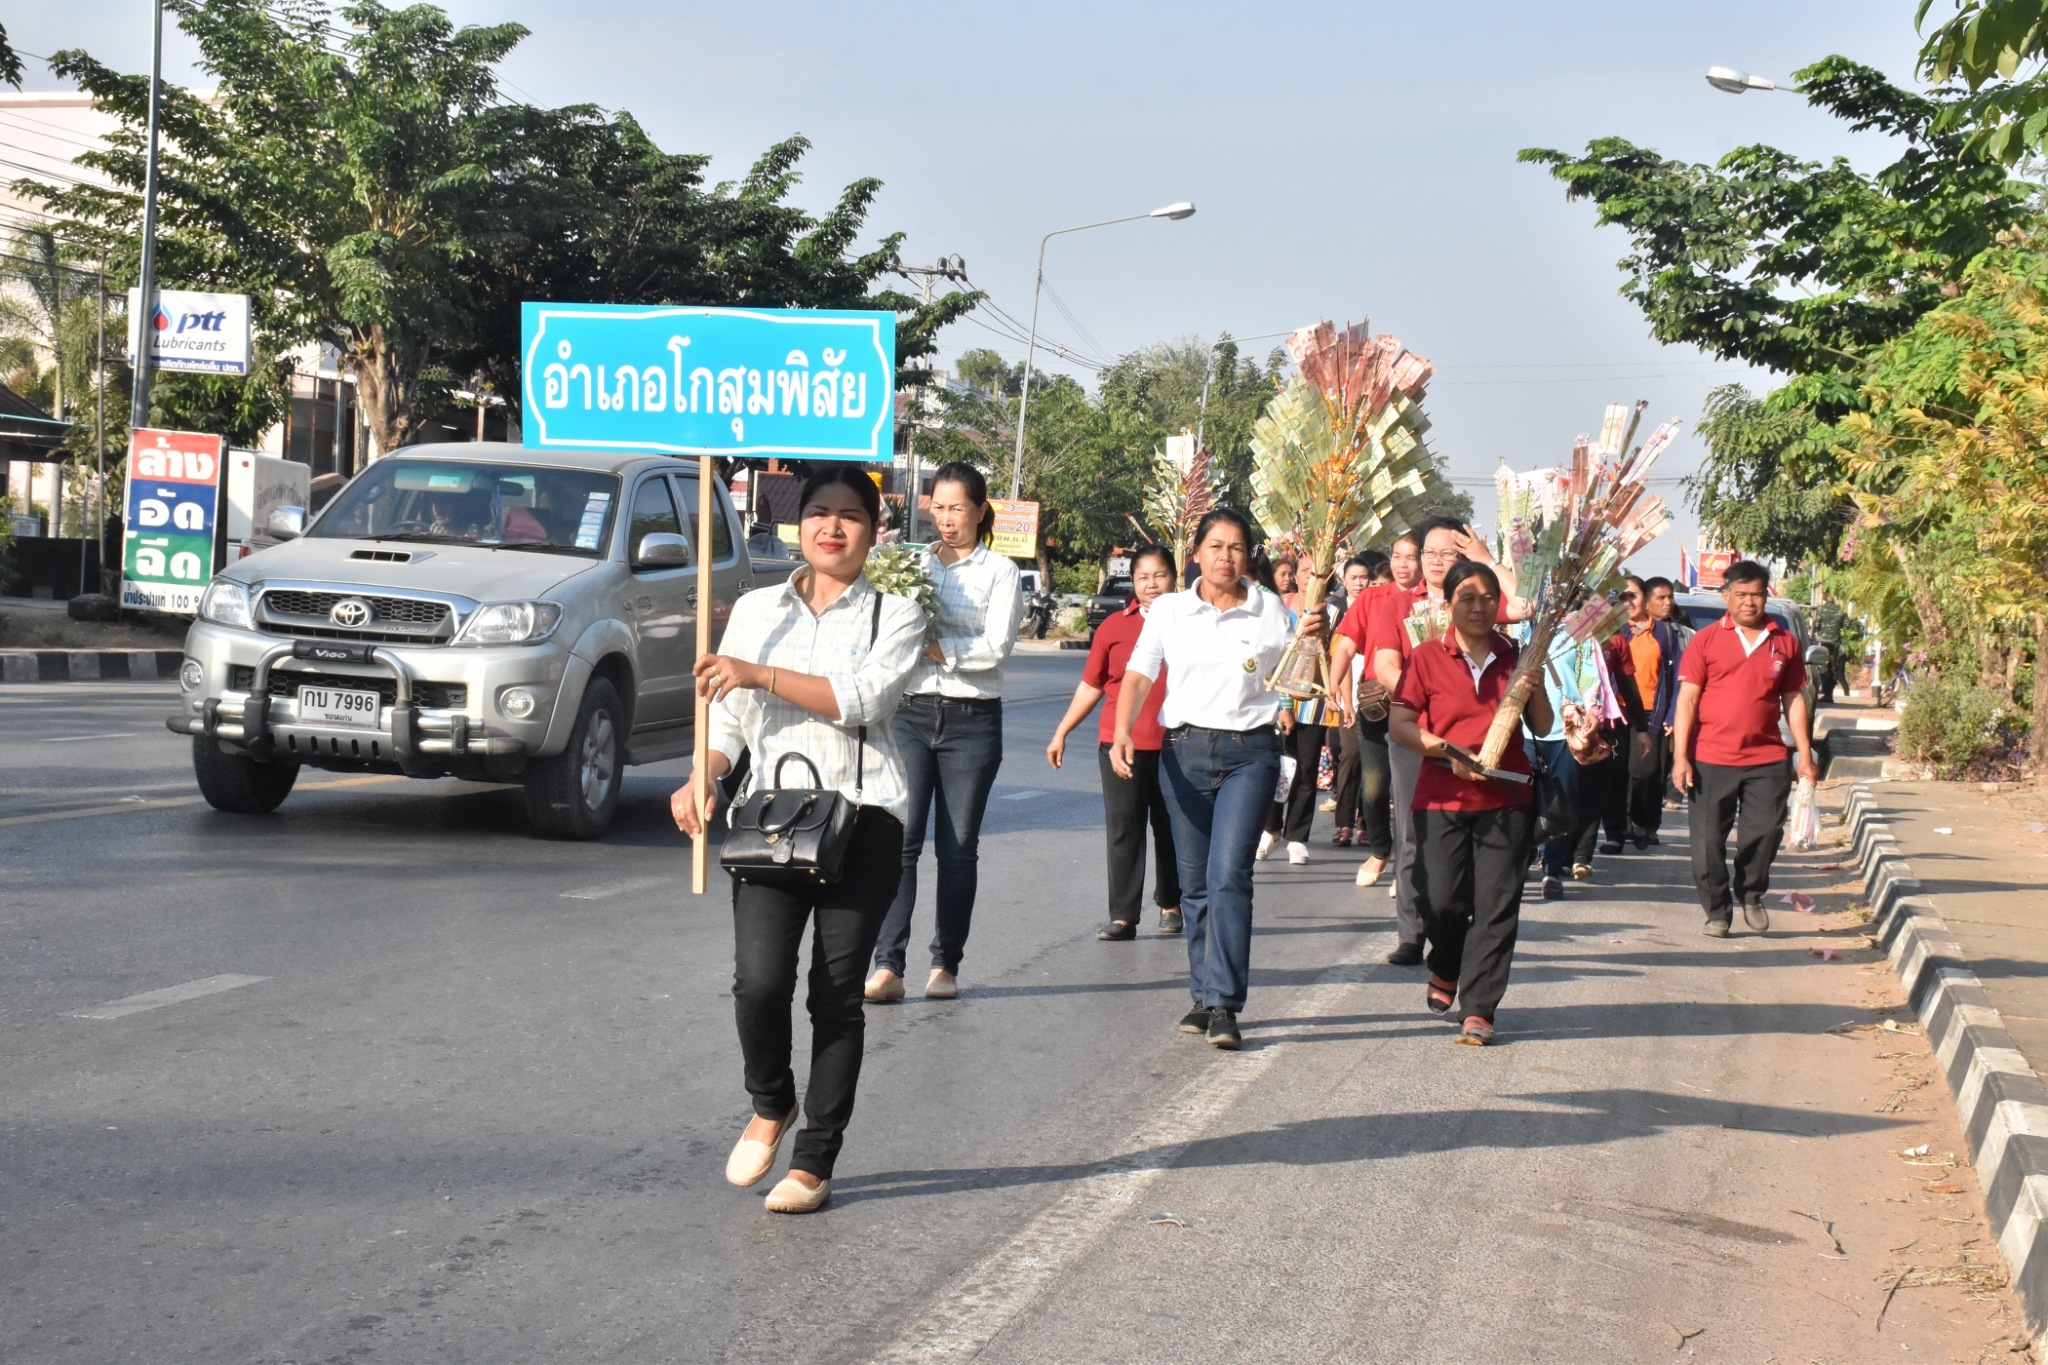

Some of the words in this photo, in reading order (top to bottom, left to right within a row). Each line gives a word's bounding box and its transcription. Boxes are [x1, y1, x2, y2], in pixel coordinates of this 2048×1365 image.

[176, 311, 227, 334] ptt
[153, 335, 227, 352] Lubricants
[543, 335, 866, 442] อำเภอโกสุมพิสัย
[138, 437, 214, 480] ล้าง
[139, 488, 205, 531] อัด
[136, 538, 201, 580] ฉีด
[172, 594, 189, 609] 100
[304, 690, 328, 708] กบ
[334, 692, 374, 712] 7996
